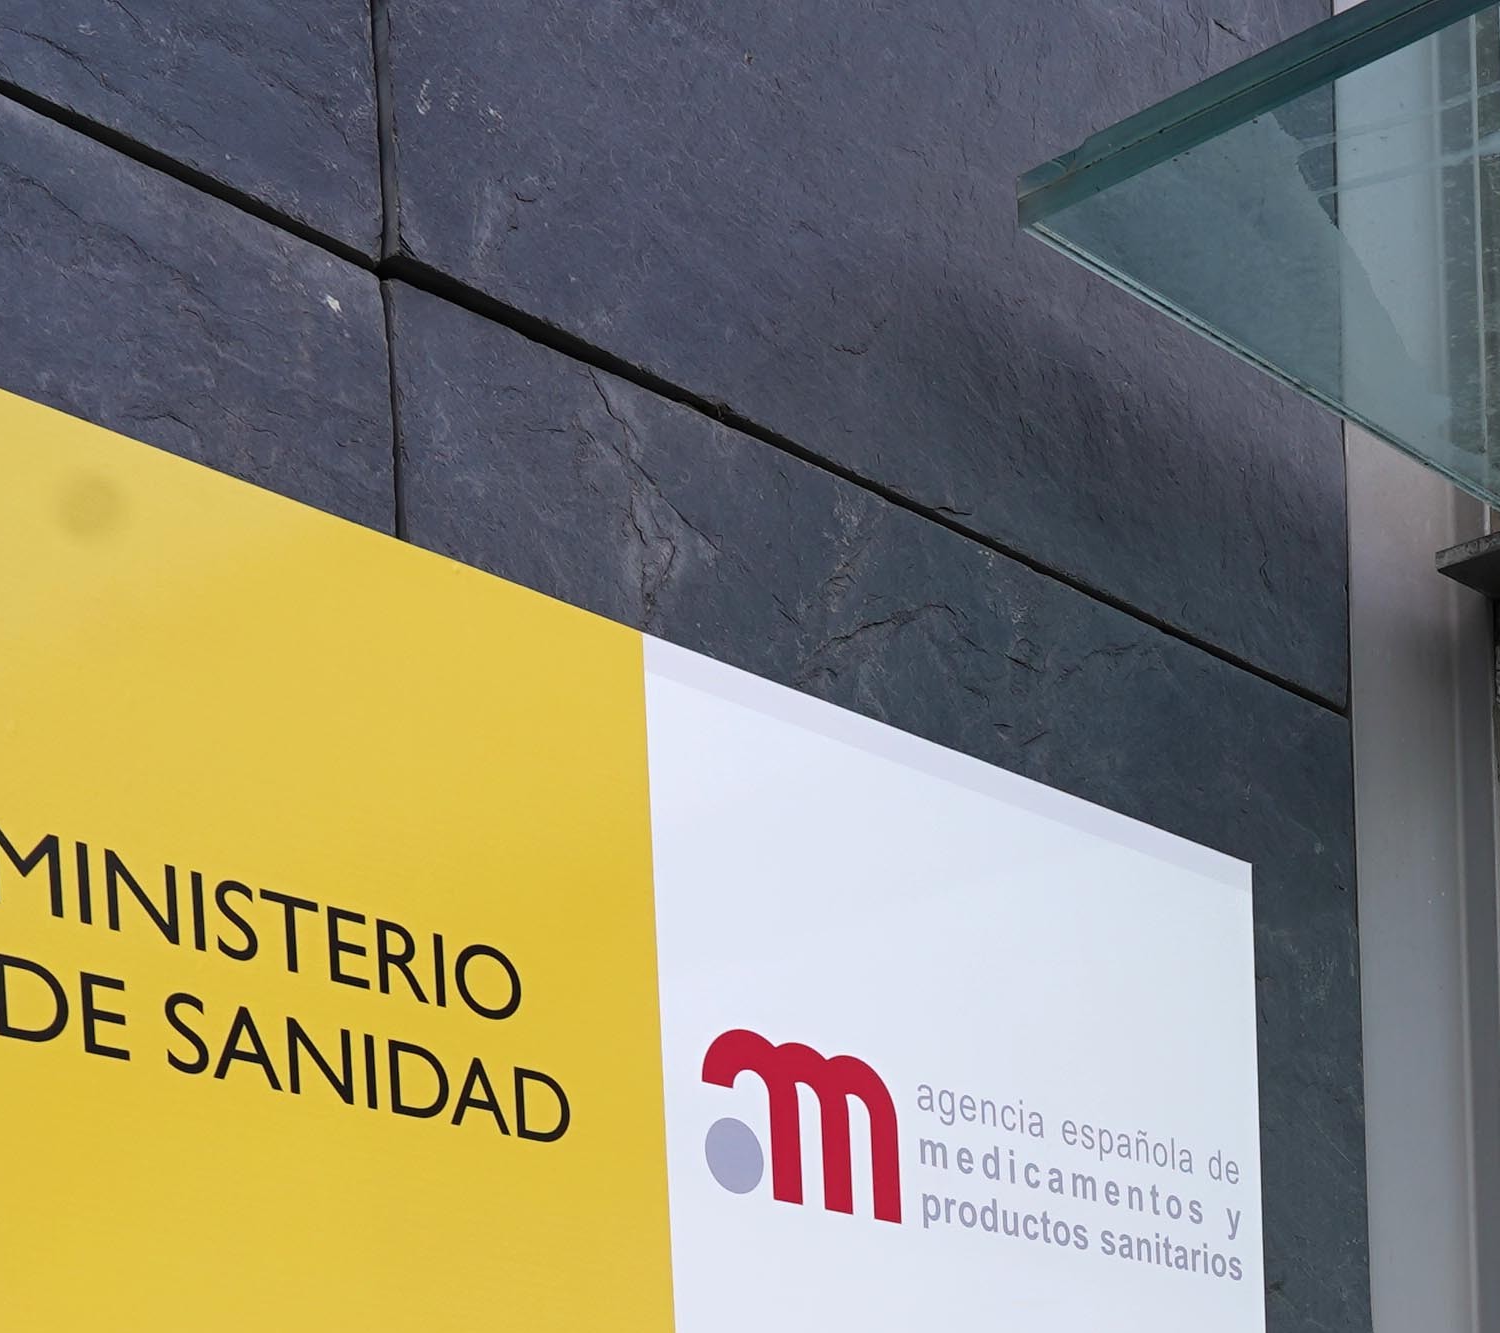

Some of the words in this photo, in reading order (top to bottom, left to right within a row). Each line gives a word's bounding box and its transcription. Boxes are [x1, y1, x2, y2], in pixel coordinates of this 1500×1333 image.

[164, 991, 571, 1144] SANIDAD
[917, 1082, 1044, 1140] agencia
[1061, 1118, 1194, 1174] española
[1209, 1148, 1240, 1185] de
[919, 1134, 1204, 1224] medicamentos
[1226, 1206, 1241, 1240] y
[922, 1190, 1089, 1251] productos
[1100, 1225, 1243, 1282] sanitarios
